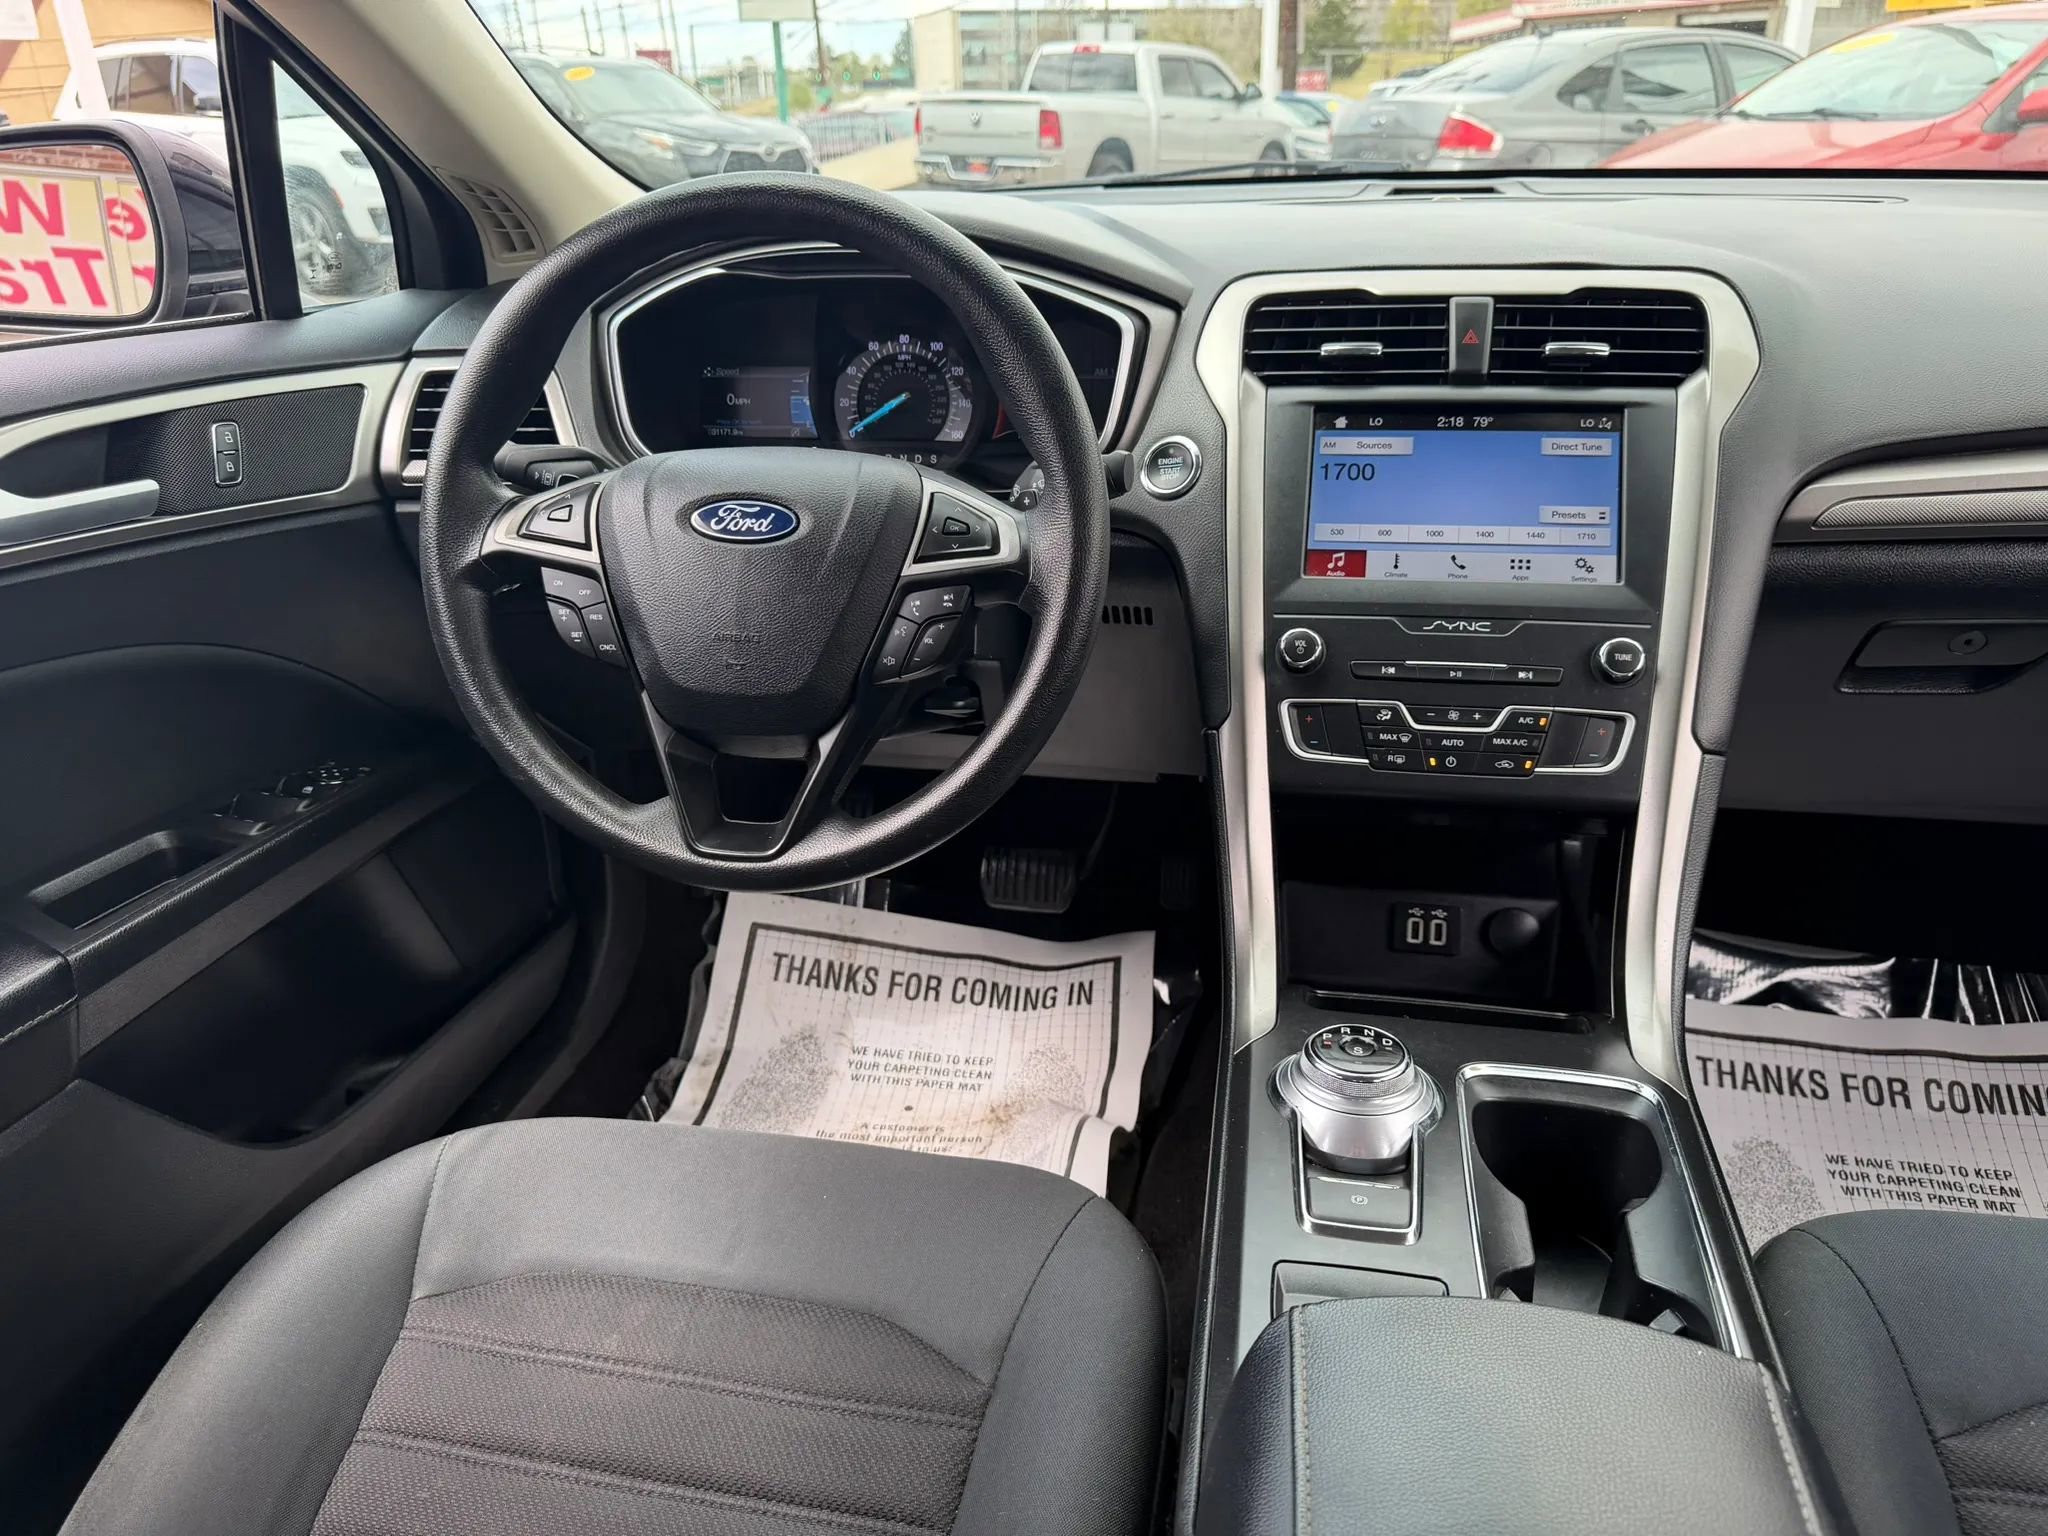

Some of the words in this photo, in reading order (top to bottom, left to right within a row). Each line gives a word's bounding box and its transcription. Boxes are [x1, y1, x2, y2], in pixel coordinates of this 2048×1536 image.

[899, 334, 910, 344] 80
[868, 341, 879, 351] 60
[930, 342, 944, 351] 100
[716, 367, 740, 378] Speed
[846, 366, 857, 375] 40
[951, 366, 964, 376] 120
[840, 398, 850, 407] 20
[958, 399, 972, 408] 140
[1369, 417, 1384, 426] LO
[1437, 416, 1464, 427] 2:18
[1580, 418, 1595, 428] LO
[951, 430, 963, 439] 160
[1322, 441, 1337, 449] AM
[1356, 441, 1393, 450] Sources
[1551, 442, 1578, 451] Direct
[1581, 443, 1603, 451] Tune
[1157, 456, 1184, 465] ENGINE
[1160, 466, 1181, 475] START
[1320, 463, 1376, 481] 1700
[710, 504, 776, 532] Ford
[1551, 510, 1587, 519] Presets
[1330, 528, 1345, 536] 530
[1476, 530, 1495, 538] 1400
[1526, 531, 1545, 539] 1440
[1577, 532, 1596, 540] 1710
[1512, 574, 1529, 582] Apps
[1571, 575, 1597, 583] Settings
[1422, 620, 1492, 632] SYNC
[599, 643, 617, 651] CNCL
[1294, 639, 1308, 647] VOL
[1614, 653, 1633, 661] TUNE
[1379, 733, 1398, 741] MAX
[1441, 739, 1464, 747] AUTO
[1492, 738, 1511, 746] MAX
[1512, 738, 1528, 746] A/C
[773, 951, 879, 997] THANKS
[887, 970, 943, 1002] FOR
[951, 976, 1058, 1012] COMING
[1067, 979, 1094, 1006] IN
[1322, 1032, 1333, 1040] P
[1340, 1026, 1351, 1034] R
[1363, 1028, 1375, 1037] N
[1382, 1037, 1393, 1046] D
[851, 1045, 870, 1056] WE
[873, 1047, 905, 1060] HAVE
[908, 1050, 941, 1063] TRIED
[946, 1054, 960, 1065] TO
[964, 1056, 994, 1066] KEEP
[847, 1058, 880, 1071] YOUR
[883, 1062, 950, 1077] CARPETING
[954, 1068, 992, 1080] CLEAN
[850, 1073, 881, 1084] WITH
[885, 1075, 912, 1087] THIS
[915, 1077, 953, 1090] PAPER
[958, 1082, 984, 1092] MAT
[1695, 1055, 1830, 1101] THANKS
[1840, 1072, 1912, 1110] FOR
[1924, 1077, 2048, 1117] COMIN
[815, 1129, 835, 1138] the
[839, 1132, 870, 1141] most
[875, 1133, 935, 1144] important
[1825, 1153, 1849, 1166] WE
[1854, 1156, 1893, 1170] HAVE
[1897, 1160, 1943, 1175] TRIED
[1949, 1165, 1969, 1177] TO
[1974, 1168, 2013, 1181] KEEP
[1826, 1169, 1871, 1183] YOUR
[1876, 1174, 1964, 1193] CARPETING
[1969, 1182, 2021, 1198] CLEAN
[1840, 1185, 1882, 1199] WITH
[1884, 1188, 1923, 1203] THIS
[1927, 1193, 1980, 1209] PAPER
[1983, 1200, 2017, 1213] MAT
